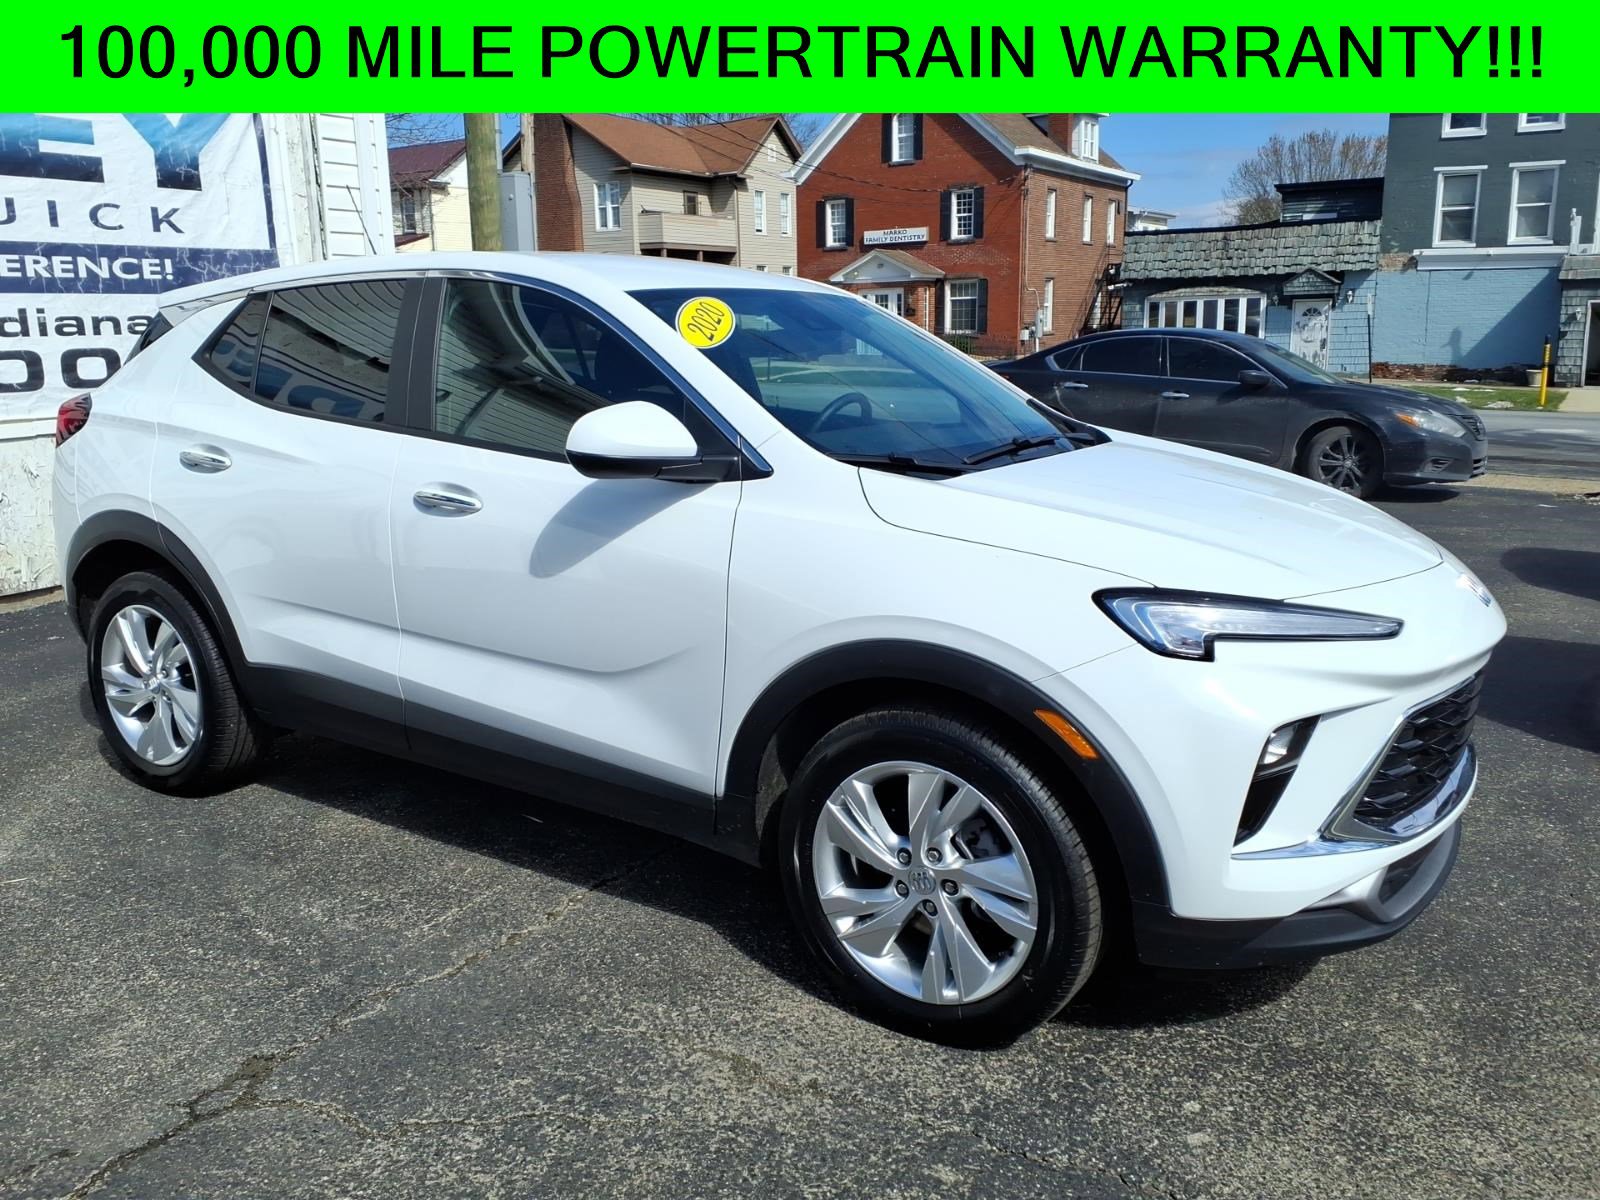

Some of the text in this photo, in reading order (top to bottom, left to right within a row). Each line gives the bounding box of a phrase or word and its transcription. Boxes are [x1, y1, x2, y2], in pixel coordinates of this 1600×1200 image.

[889, 234, 925, 242] DENTISTRY
[0, 254, 174, 281] ERENCE!
[687, 301, 725, 342] 2020
